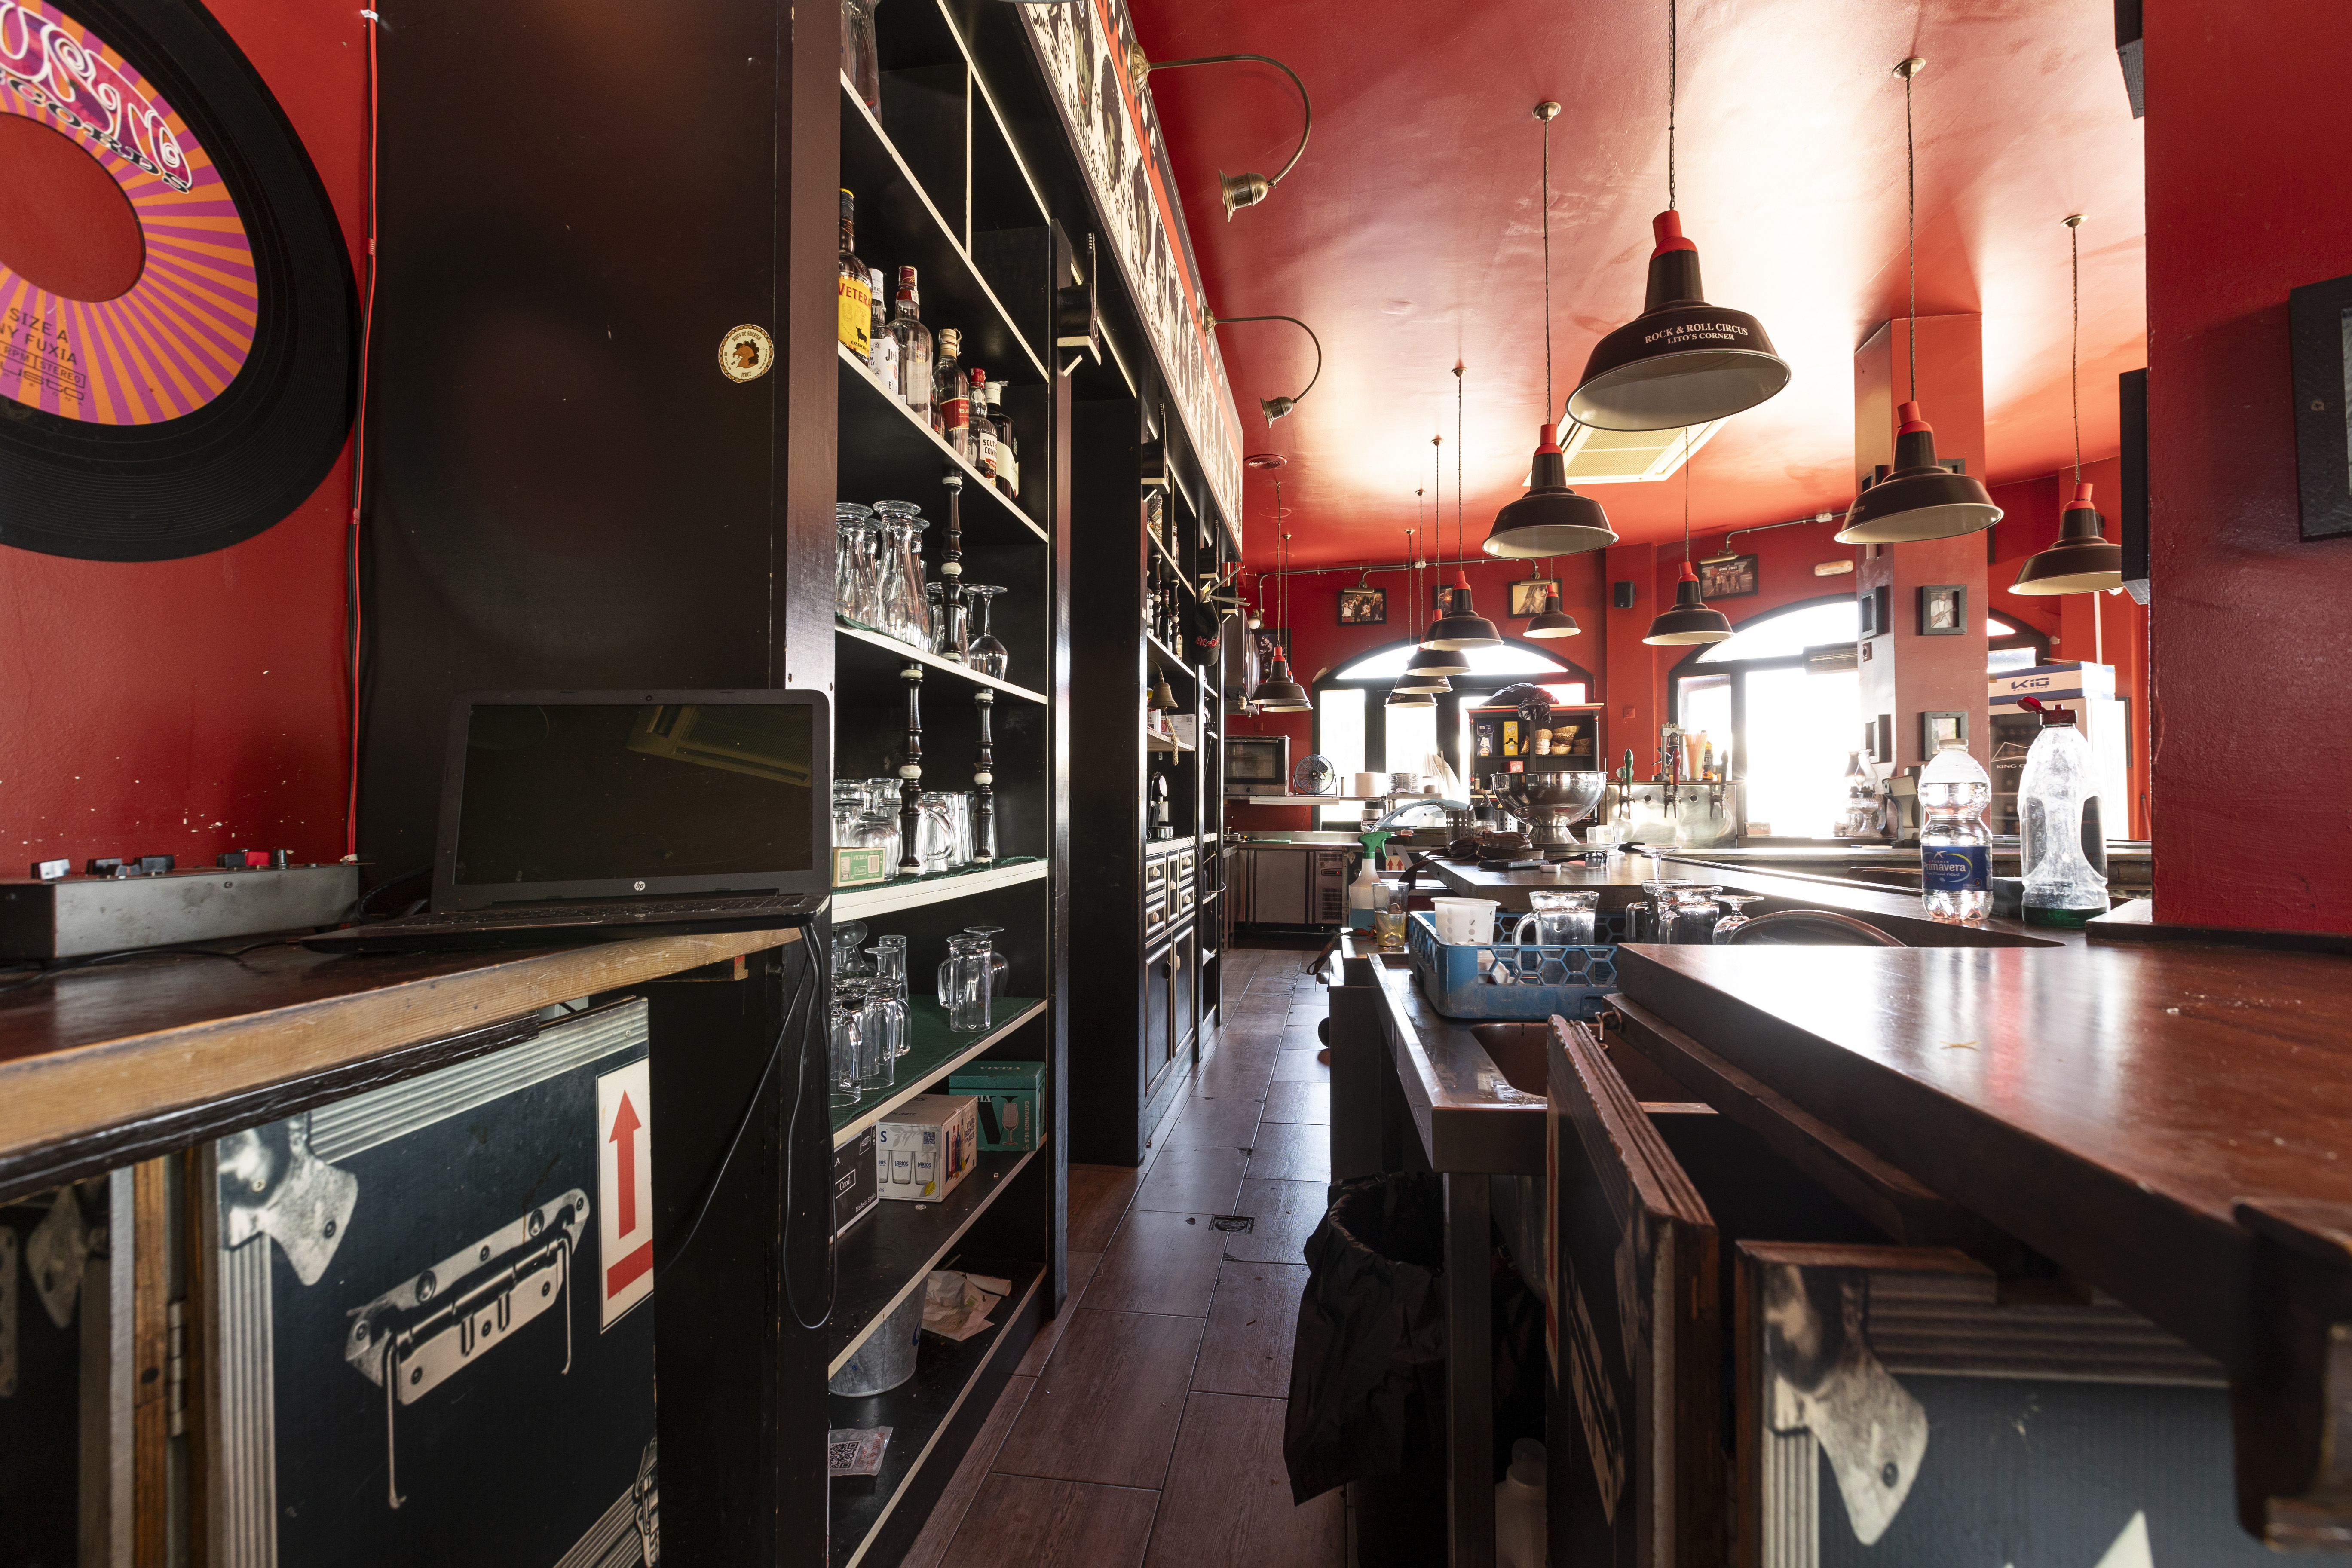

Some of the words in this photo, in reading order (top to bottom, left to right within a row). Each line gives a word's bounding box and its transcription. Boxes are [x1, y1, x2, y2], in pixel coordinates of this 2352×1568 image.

[0, 69, 190, 193] CORDS
[839, 282, 871, 311] VETERA
[9, 308, 52, 336] SIZE
[57, 330, 68, 343] A
[1645, 328, 1674, 344] ROCK
[1676, 326, 1684, 334] &
[1686, 323, 1714, 332] ROLL
[1715, 323, 1748, 336] CIRCUS
[732, 333, 741, 342] HIJOS
[26, 334, 77, 365] FUXIA
[41, 362, 81, 383] STEREO
[1923, 861, 1966, 872] Primavera
[636, 881, 644, 891] hp
[839, 1176, 851, 1191] Conil
[856, 1202, 864, 1213] Made
[868, 1193, 876, 1204] Spain
